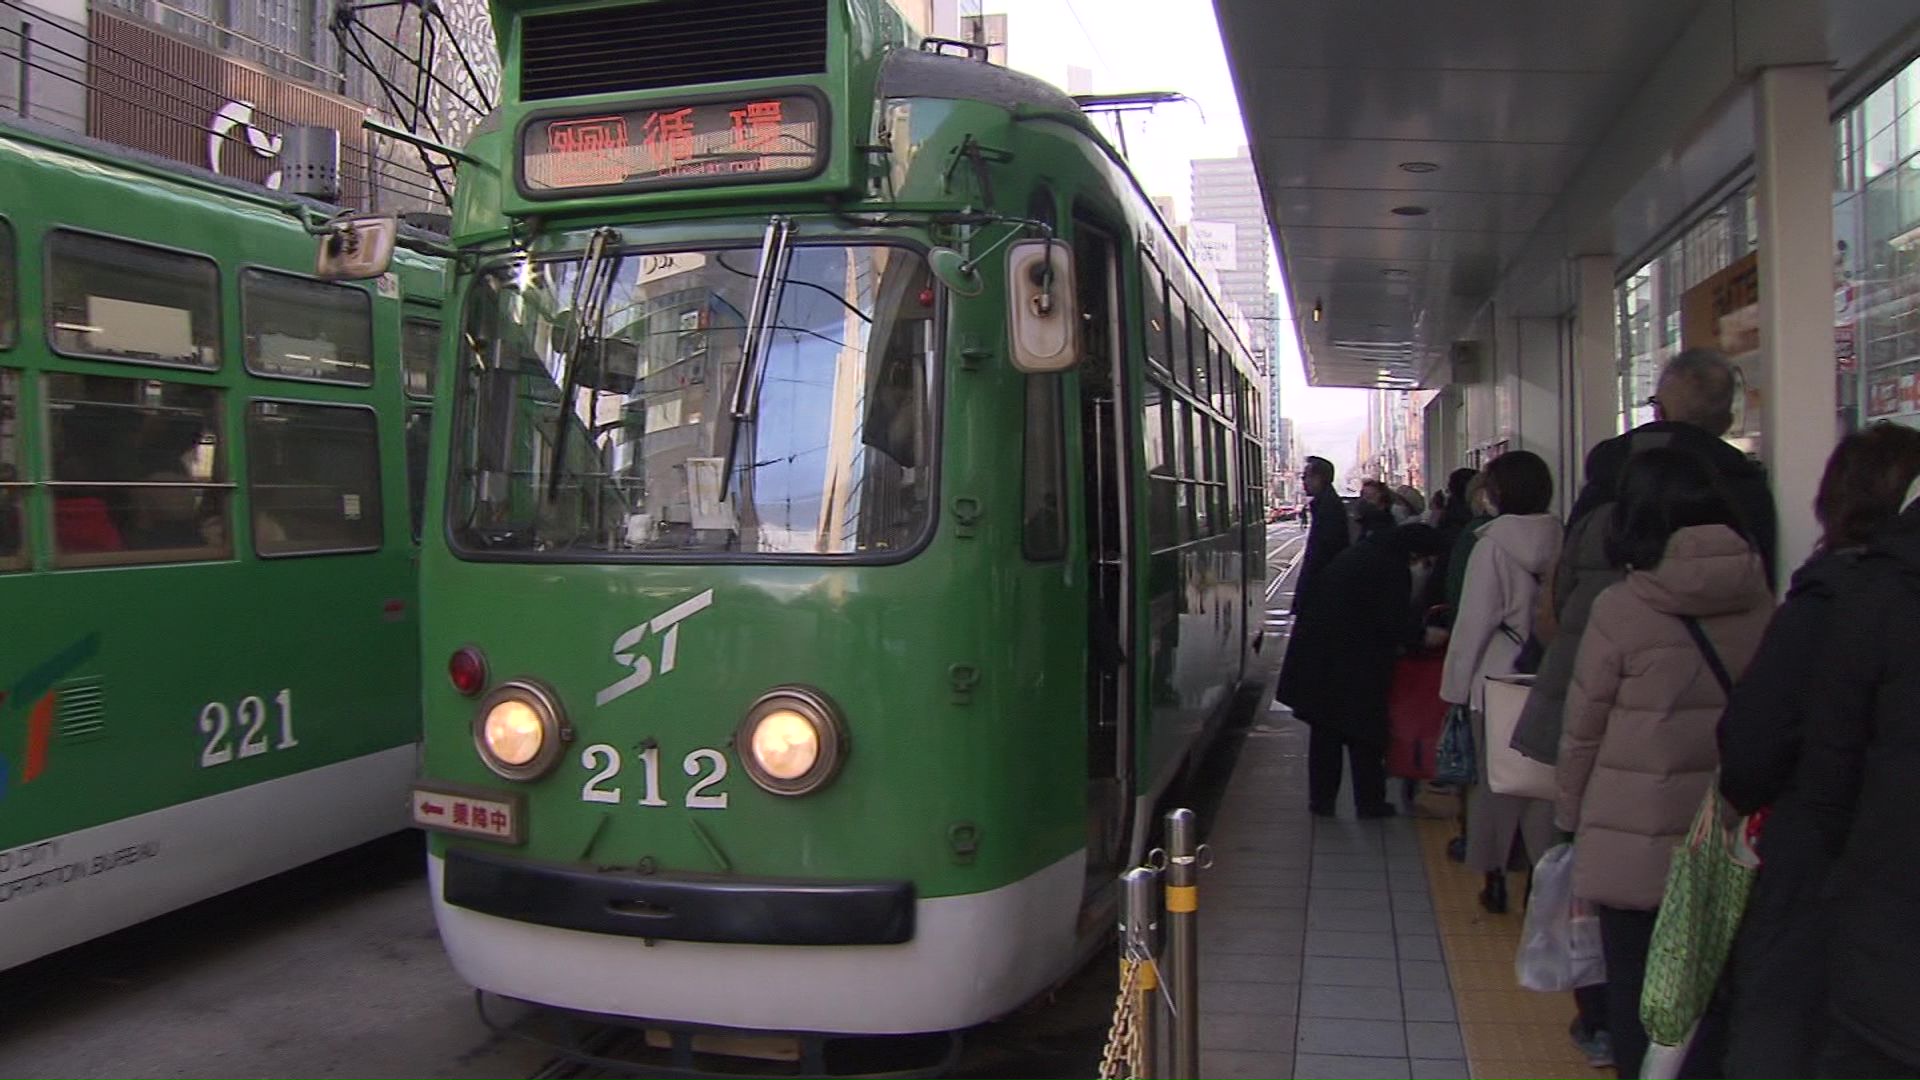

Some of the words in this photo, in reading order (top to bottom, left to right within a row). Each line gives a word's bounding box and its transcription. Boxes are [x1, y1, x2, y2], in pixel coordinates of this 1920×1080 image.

[642, 101, 782, 161] 循環
[200, 688, 299, 768] 221
[582, 744, 728, 808] 212
[452, 801, 507, 833] 乗降中
[19, 841, 62, 867] CITY
[88, 840, 160, 876] BUREAU
